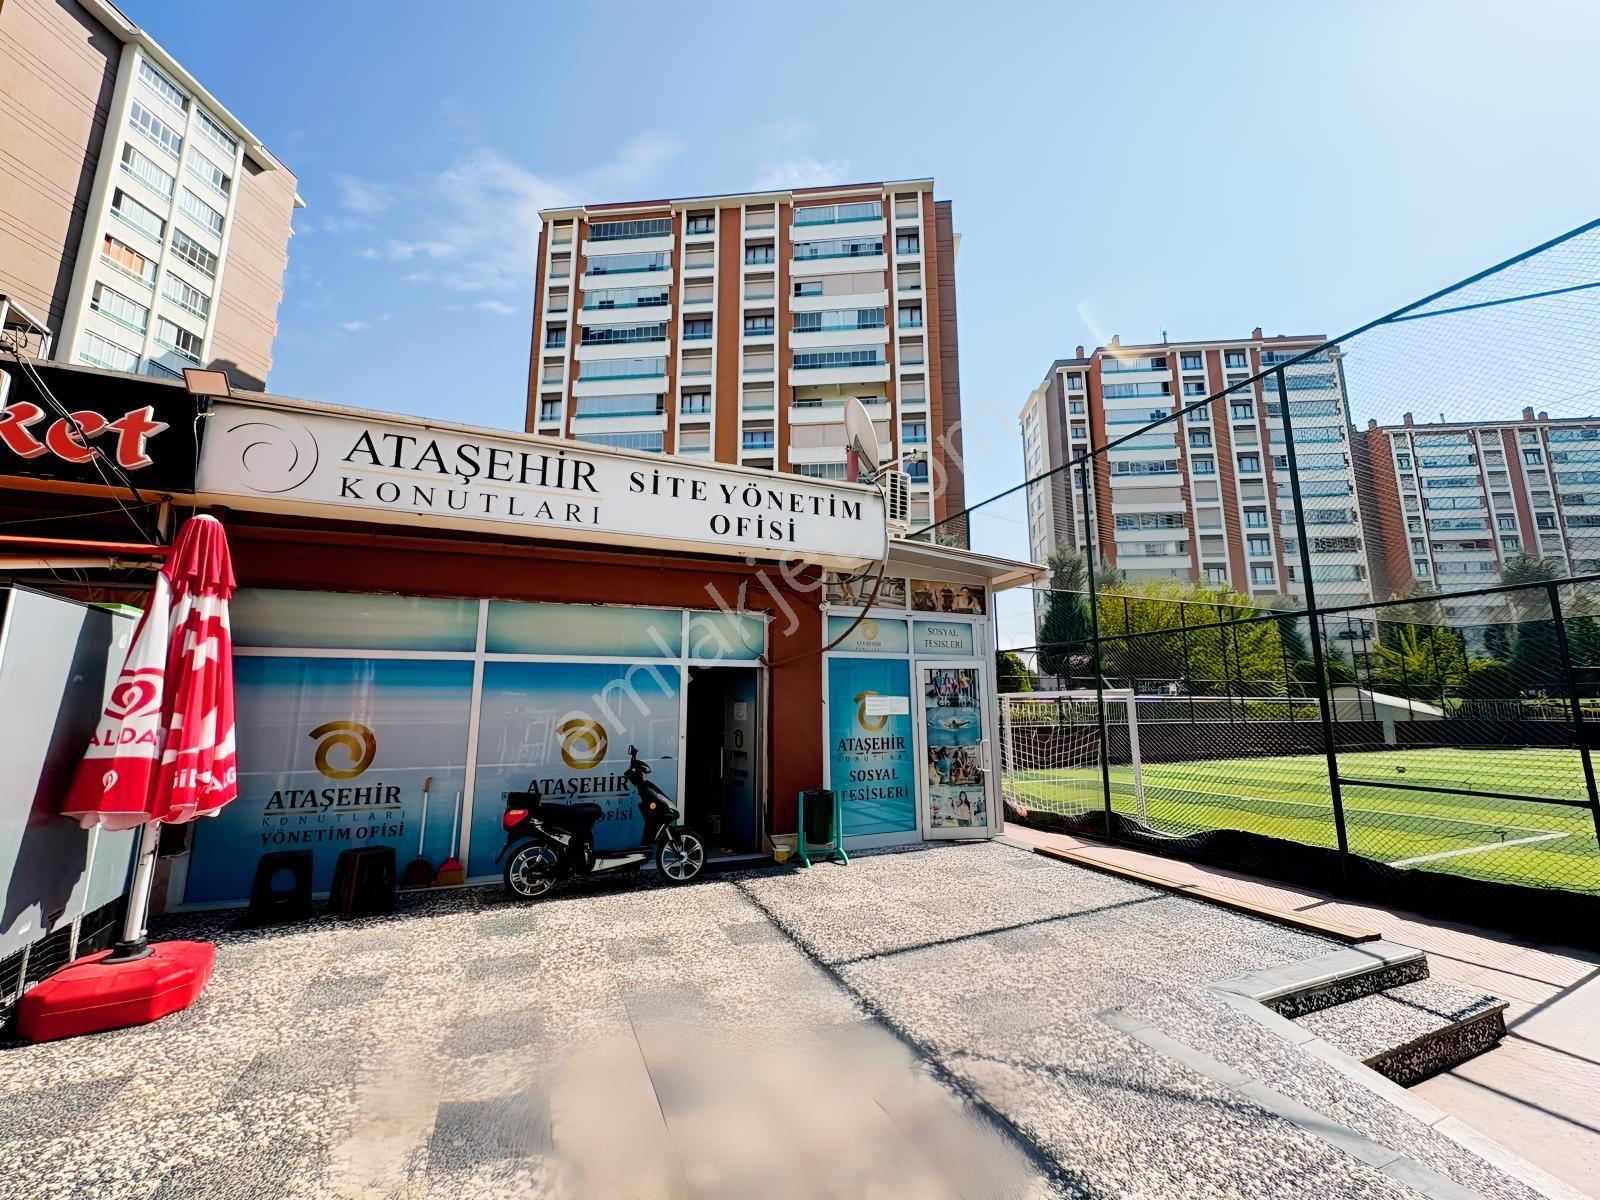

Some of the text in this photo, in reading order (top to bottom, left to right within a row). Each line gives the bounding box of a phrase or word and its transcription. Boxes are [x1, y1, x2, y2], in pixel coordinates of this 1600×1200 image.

[341, 429, 600, 494] ATAŞEHİR
[338, 476, 600, 525] KONUTLARI
[629, 469, 862, 521] SİTE YÖNETİM
[709, 514, 797, 543] OFİSİ
[837, 733, 906, 754] ATAŞEHİR
[527, 772, 630, 800] ATAŞEHİR
[848, 767, 899, 783] SOSYAL
[263, 782, 402, 813] ATAŞEHİR
[262, 810, 406, 827] KONUTLARI
[260, 821, 405, 846] YÖNETİM OFİSİ
